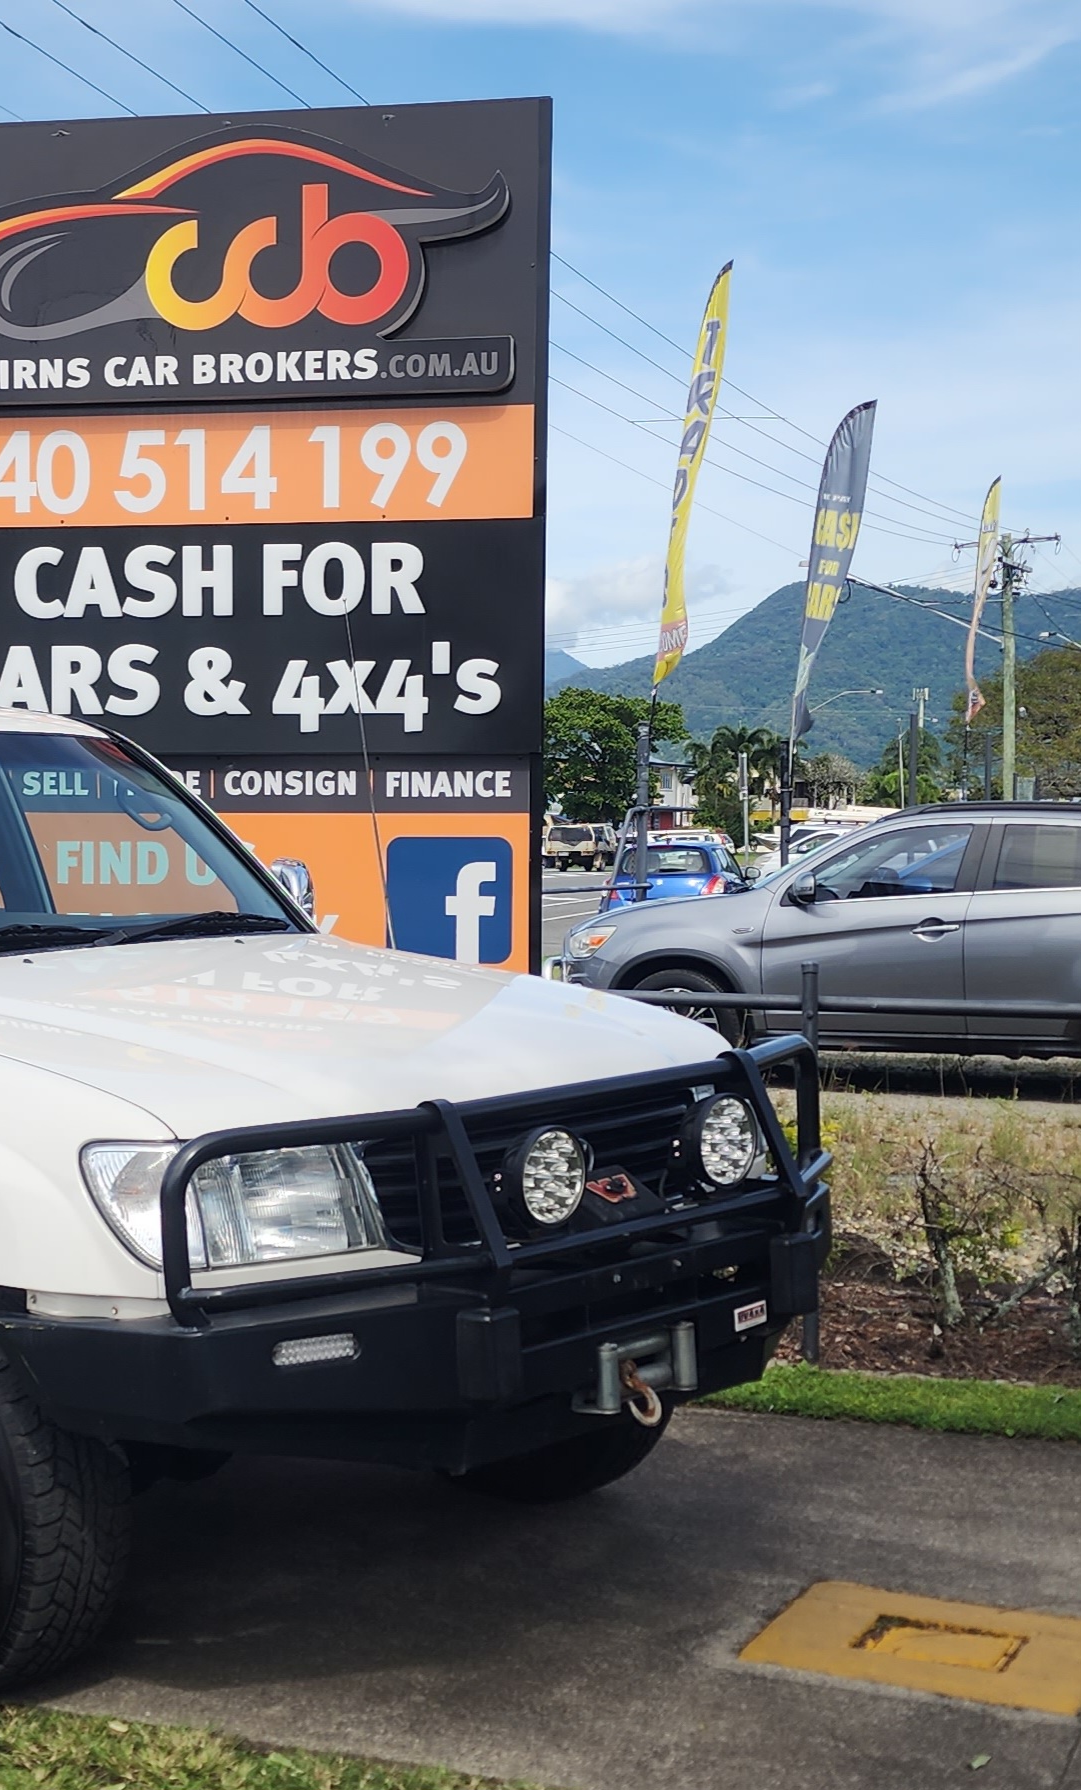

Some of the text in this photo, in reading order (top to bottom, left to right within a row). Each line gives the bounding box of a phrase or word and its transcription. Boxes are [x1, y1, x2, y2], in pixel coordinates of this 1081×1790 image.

[103, 356, 180, 388] CAR
[113, 425, 278, 514] 514
[307, 420, 468, 510] 199
[14, 541, 426, 619] CASH FOR
[183, 646, 251, 717] &
[22, 771, 89, 796] SELL
[224, 770, 357, 797] CONSIGN
[385, 770, 512, 799] FINANCE
[56, 840, 169, 885] FIND
